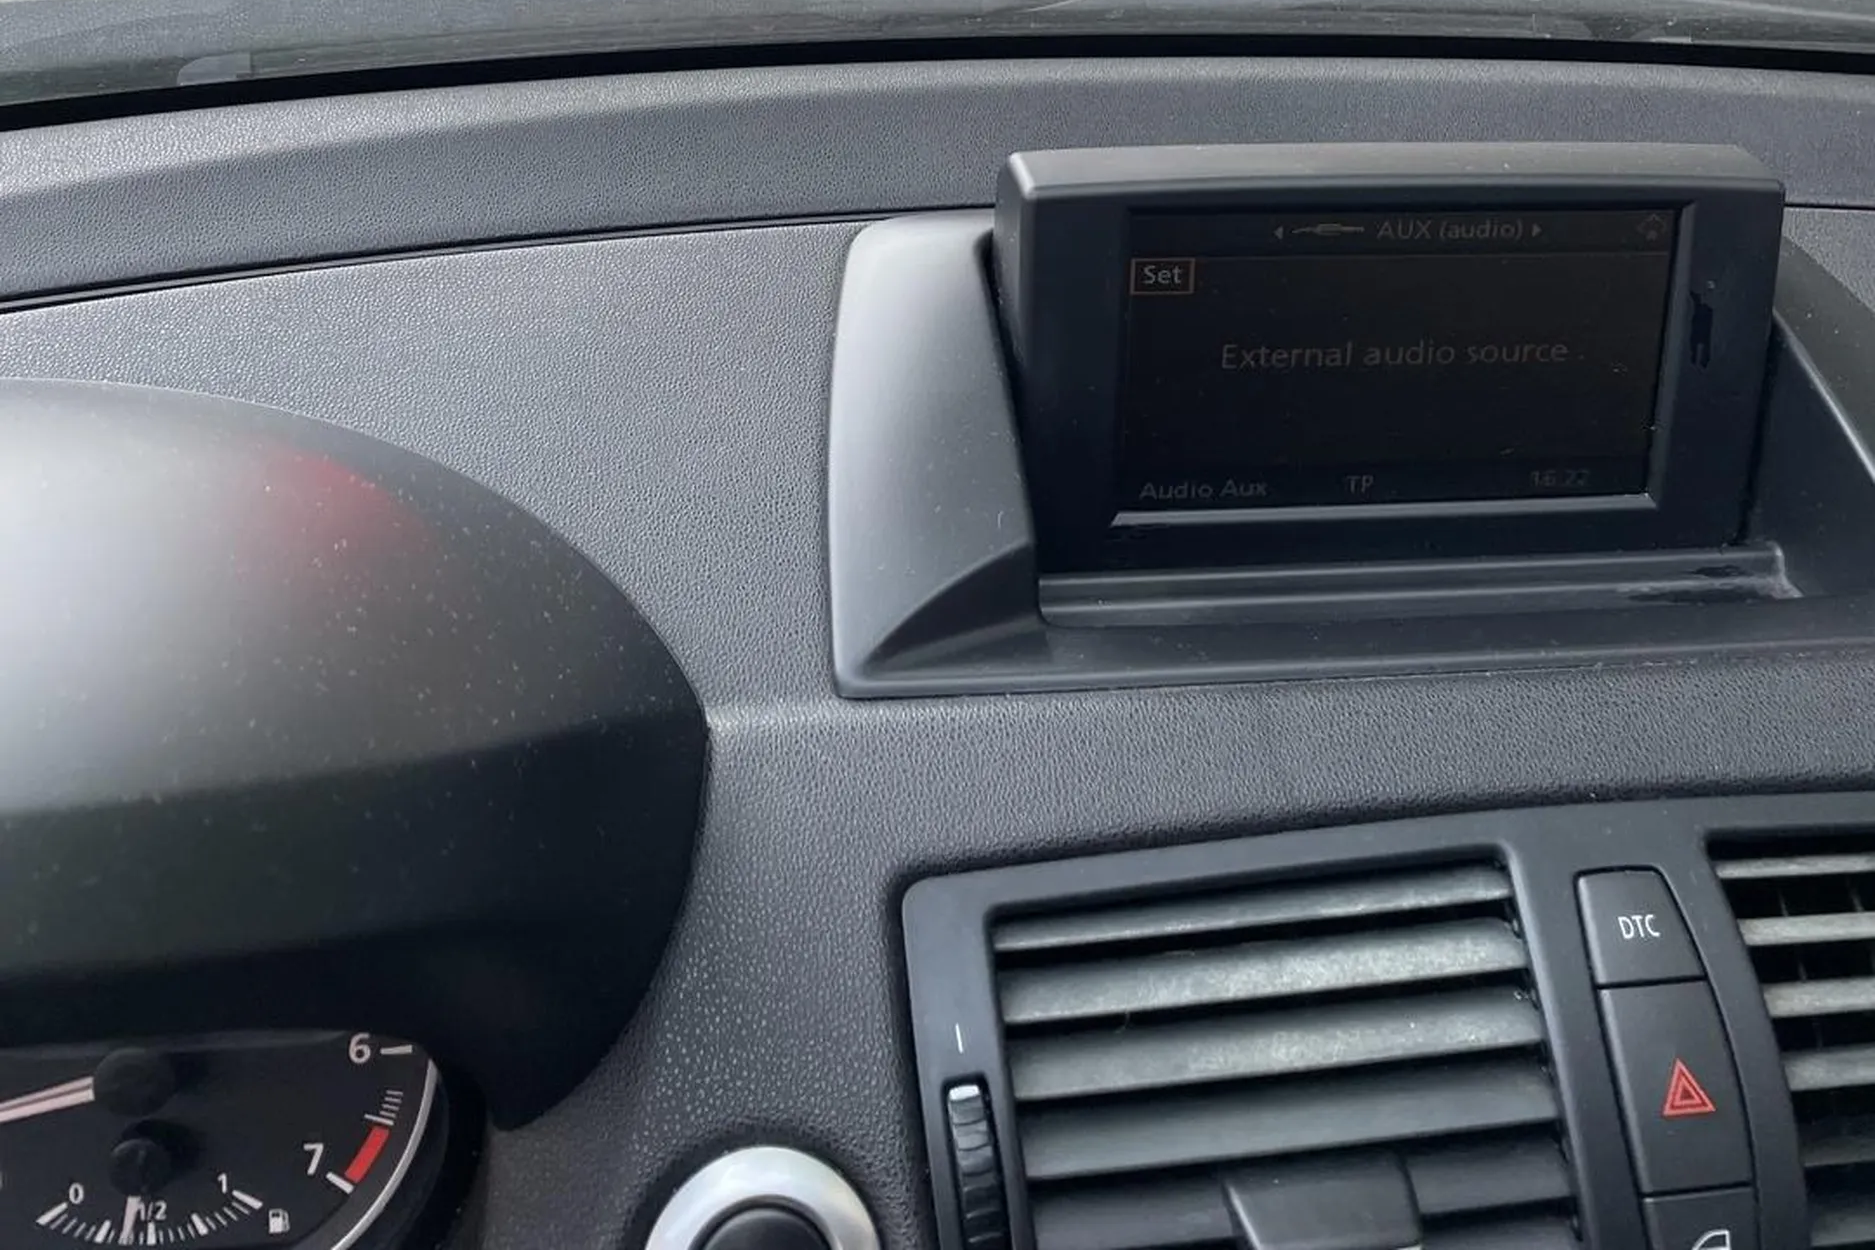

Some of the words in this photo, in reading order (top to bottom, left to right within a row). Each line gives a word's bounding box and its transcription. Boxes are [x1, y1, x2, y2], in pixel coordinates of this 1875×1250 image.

[1377, 220, 1431, 240] AUX
[1440, 219, 1524, 241] (audio)
[1143, 265, 1182, 285] Set
[1221, 342, 1351, 370] External
[1364, 340, 1455, 366] audio
[1468, 341, 1568, 364] source
[1139, 481, 1211, 500] Audio
[1219, 478, 1268, 499] Aux
[1347, 475, 1375, 493] TP
[1618, 913, 1661, 939] DTC
[349, 1033, 371, 1064] 6
[303, 1143, 324, 1176] 7
[69, 1182, 84, 1205] 0
[218, 1173, 228, 1193] 1
[138, 1201, 167, 1221] 1/2
